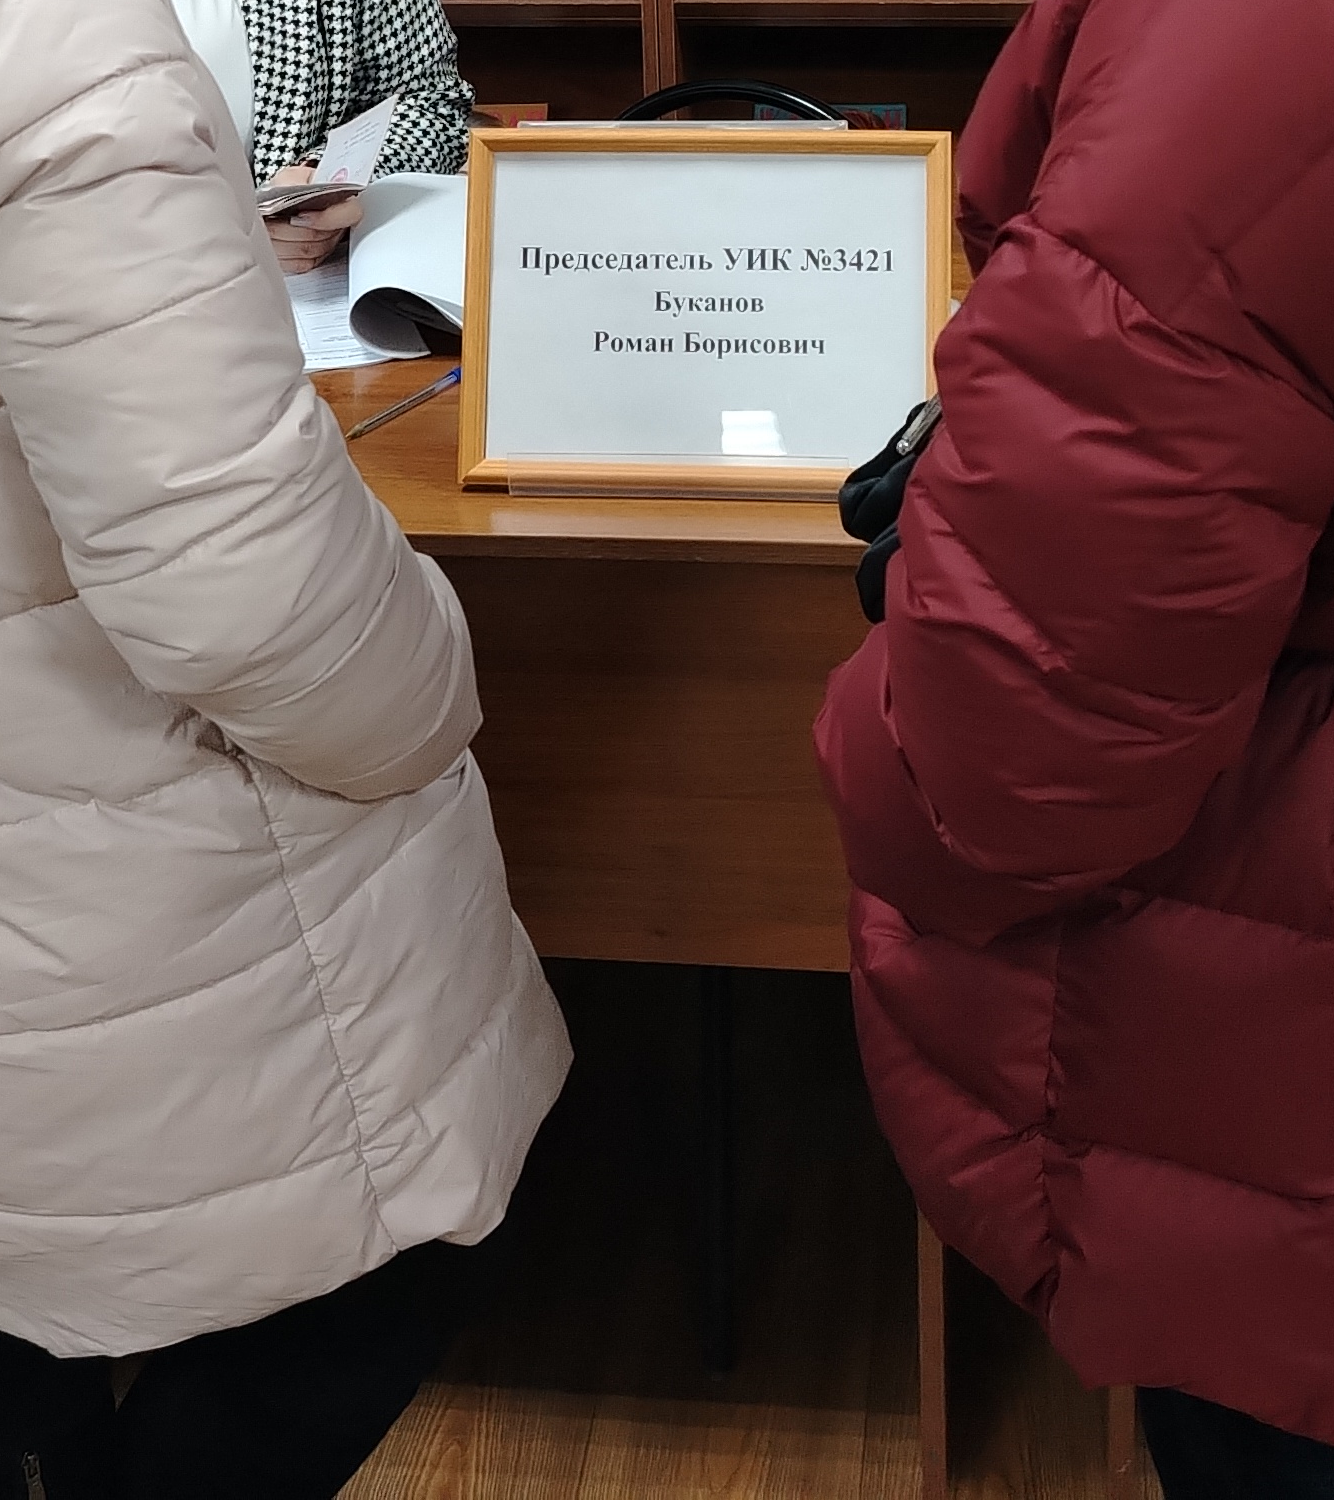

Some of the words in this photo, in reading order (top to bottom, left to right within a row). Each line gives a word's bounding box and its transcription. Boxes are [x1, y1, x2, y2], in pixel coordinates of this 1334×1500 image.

[519, 246, 714, 276] Председатель
[722, 247, 792, 271] УИК
[800, 248, 895, 272] №3421
[654, 290, 765, 318] Буканов
[593, 330, 674, 353] Роман
[683, 331, 825, 360] Борисович
